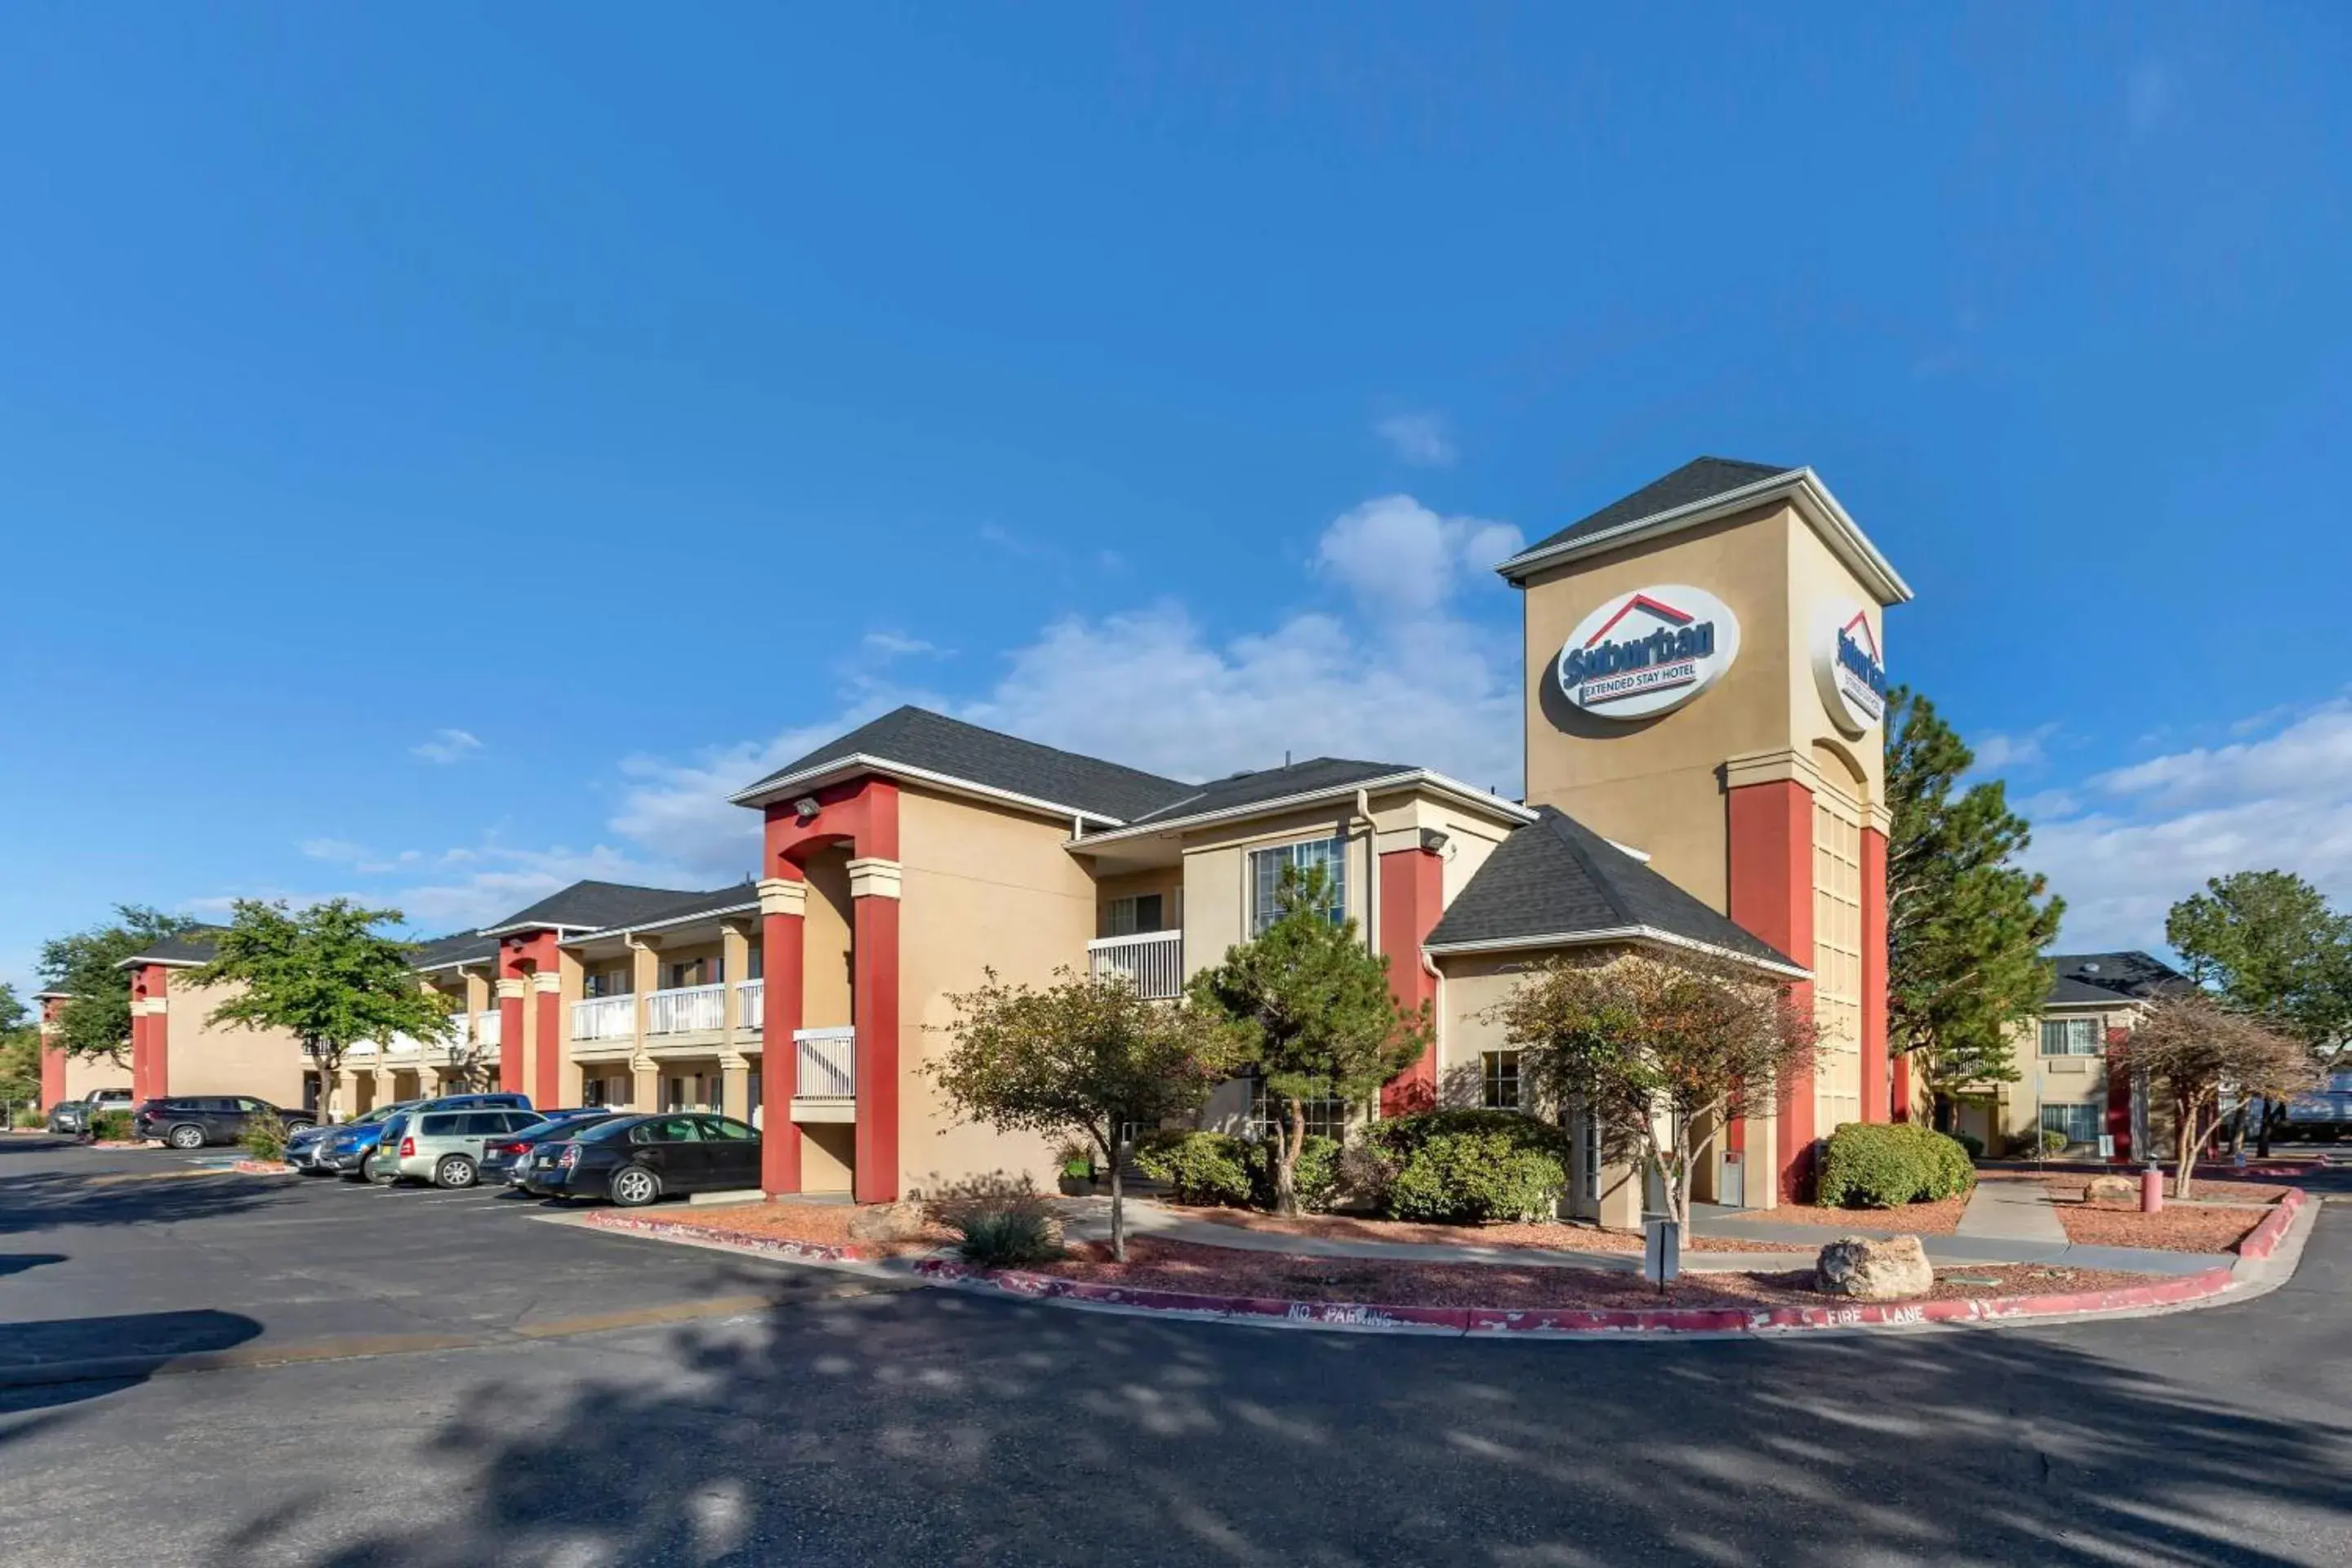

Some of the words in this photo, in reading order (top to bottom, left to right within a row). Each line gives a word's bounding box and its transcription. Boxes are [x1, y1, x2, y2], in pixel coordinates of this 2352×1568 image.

[1563, 621, 1714, 690] Suburban
[1585, 677, 1633, 697] EXTENDED
[1637, 671, 1659, 685] STAY
[1663, 664, 1695, 679] HOTEL
[1289, 1304, 1310, 1320] NO
[1325, 1307, 1392, 1325] PARKING
[1826, 1309, 1861, 1325] FIRE
[1881, 1306, 1925, 1324] LANE
